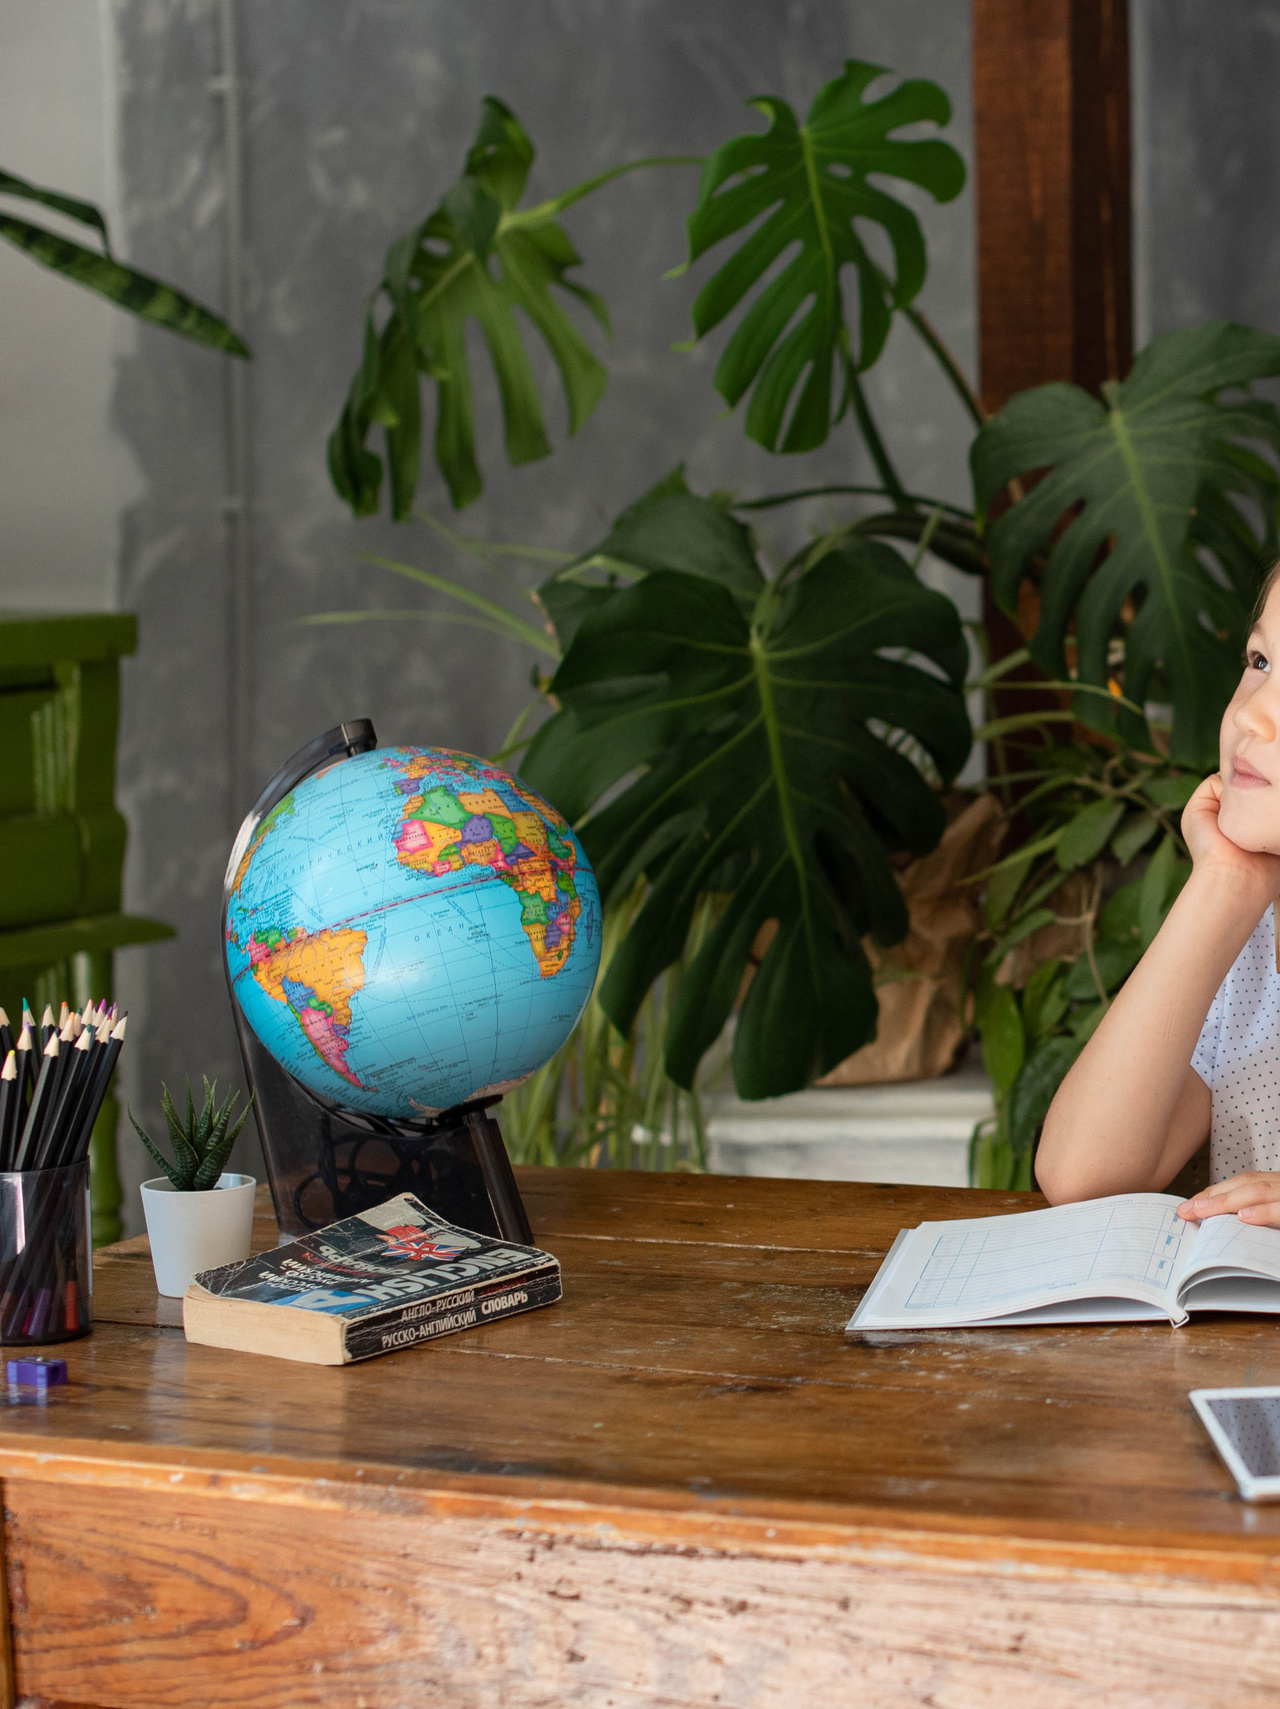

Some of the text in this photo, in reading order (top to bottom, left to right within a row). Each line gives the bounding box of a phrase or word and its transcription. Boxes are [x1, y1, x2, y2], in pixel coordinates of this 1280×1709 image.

[414, 922, 465, 943] ОКЕАН
[352, 1248, 534, 1300] ENGLISH
[400, 1290, 475, 1323] АНГЛО-РУССКИЙ
[481, 1290, 529, 1316] СЛОВАРЬ
[381, 1309, 477, 1349] РУССКО-АНГЛИЙСКИЙ
